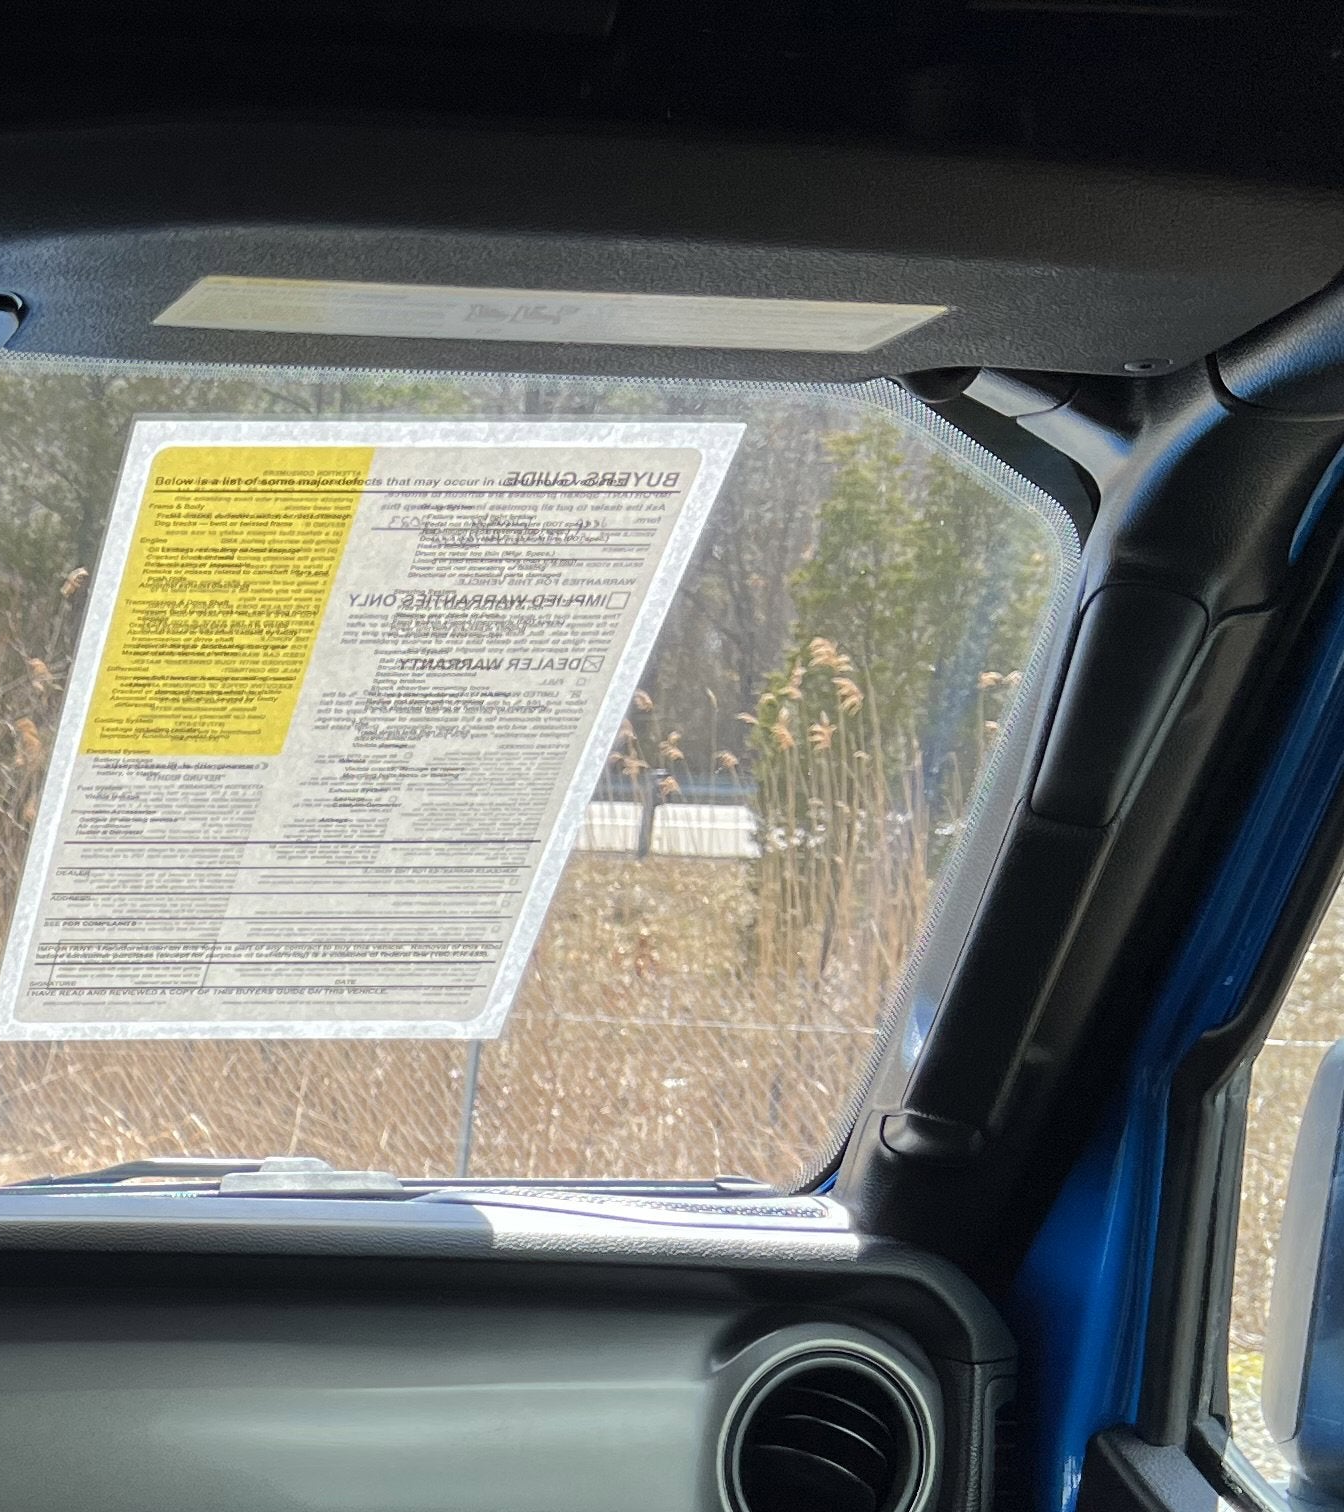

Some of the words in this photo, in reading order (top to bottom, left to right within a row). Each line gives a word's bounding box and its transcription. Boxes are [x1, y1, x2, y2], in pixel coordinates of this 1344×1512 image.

[155, 476, 193, 487] Below
[197, 477, 208, 486] is
[222, 476, 241, 486] list
[245, 476, 258, 486] of
[261, 478, 296, 487] some
[298, 477, 334, 488] major
[386, 476, 410, 487] that
[414, 478, 441, 490] may
[444, 478, 480, 487] occur
[483, 476, 495, 487] in
[184, 503, 205, 511] Body
[140, 536, 168, 545] Engine
